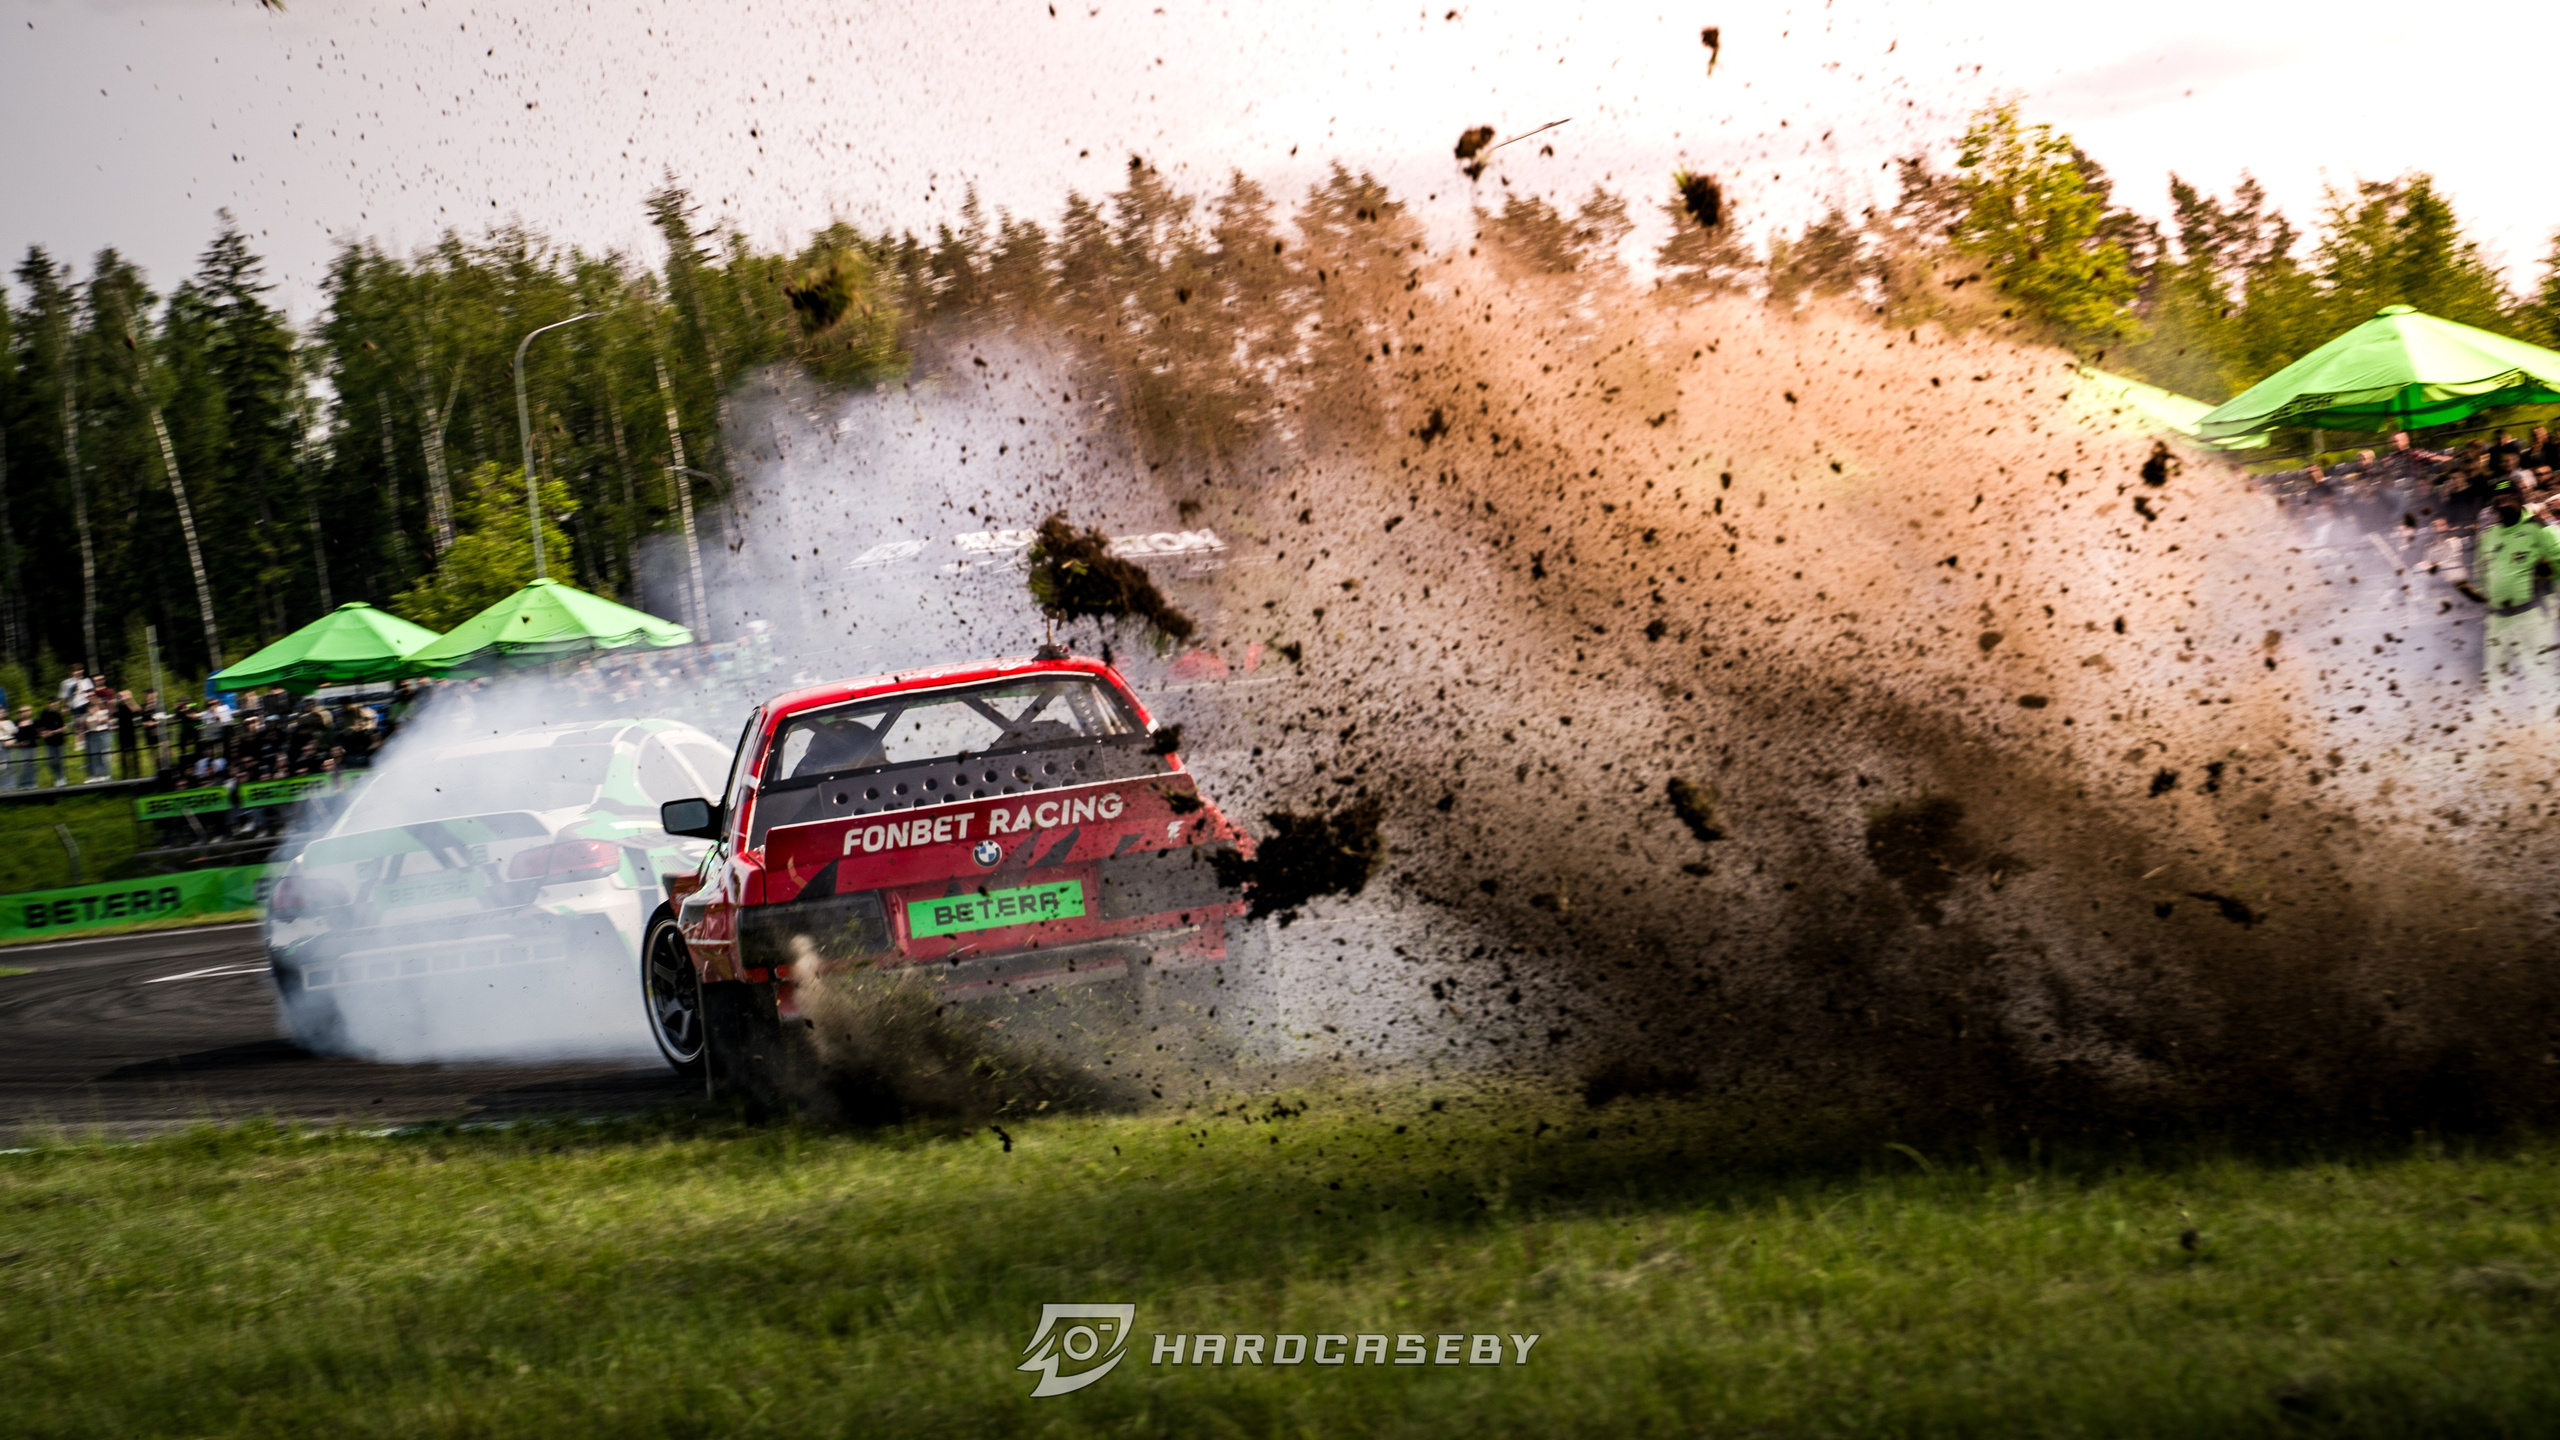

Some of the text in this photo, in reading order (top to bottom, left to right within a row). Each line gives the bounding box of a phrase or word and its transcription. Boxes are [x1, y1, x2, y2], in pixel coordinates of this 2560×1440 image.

[843, 793, 1124, 856] FONBET RACING
[24, 885, 182, 929] BETERA
